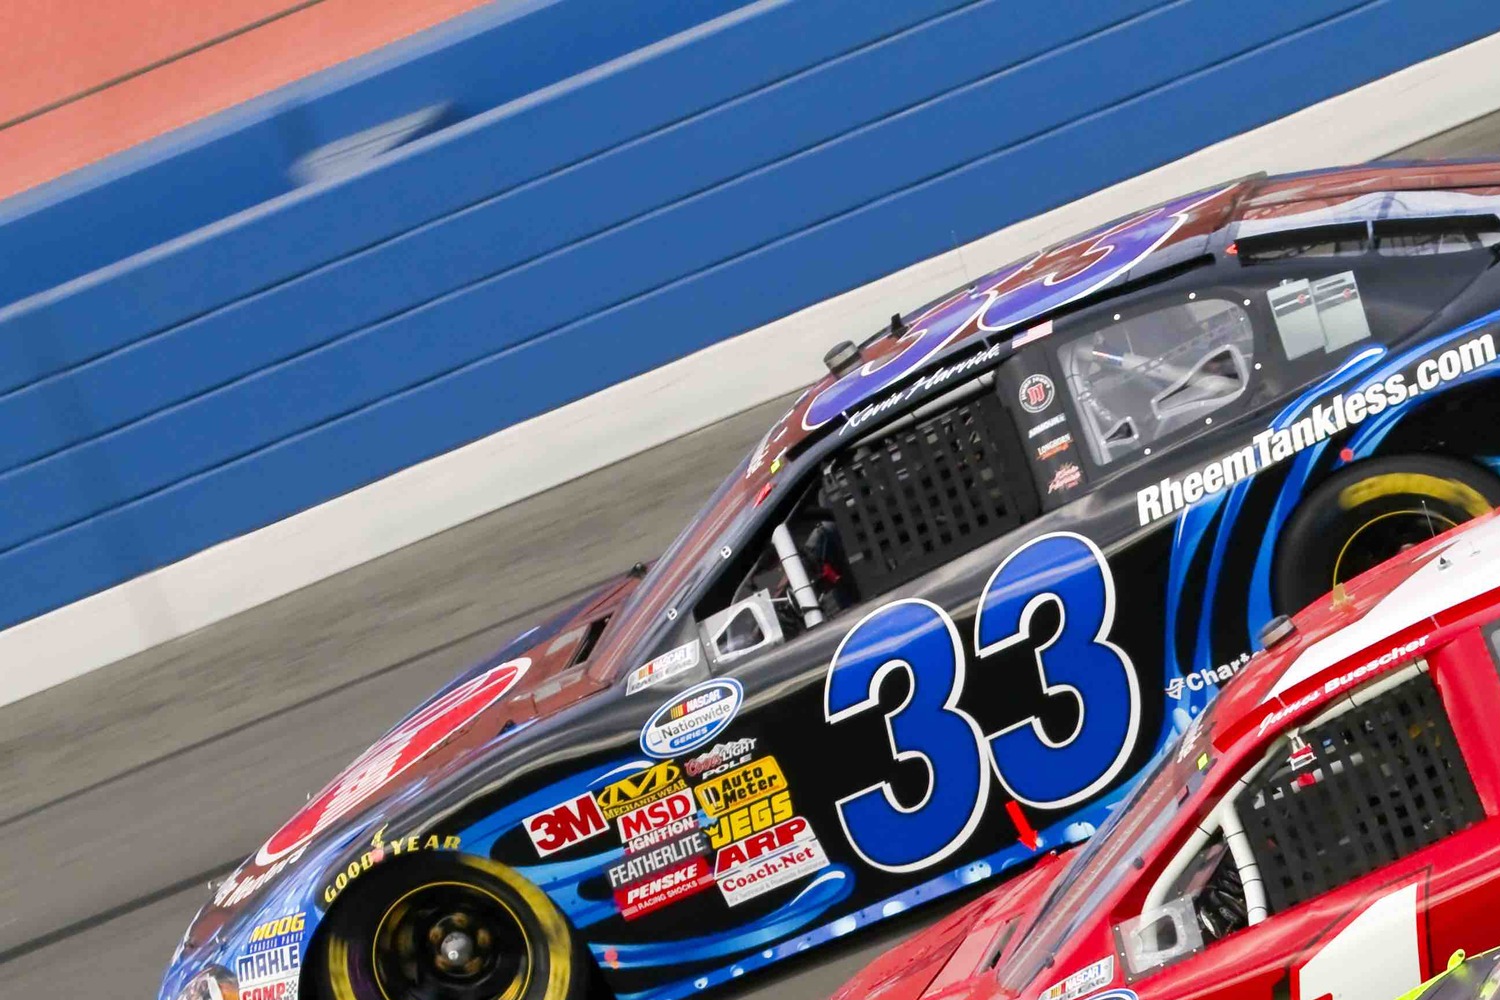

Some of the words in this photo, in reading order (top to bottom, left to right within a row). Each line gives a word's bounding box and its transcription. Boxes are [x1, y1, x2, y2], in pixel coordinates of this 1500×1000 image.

[839, 388, 902, 436] Kevin
[904, 342, 1001, 402] Harvick
[1137, 333, 1498, 527] RheemTankless.com
[1186, 649, 1265, 692] Chart
[1257, 690, 1321, 738] James
[1324, 633, 1430, 694] Buescher
[661, 702, 731, 738] Nationwide
[686, 689, 721, 713] NASCAR
[824, 531, 1141, 873] 33
[673, 726, 709, 747] SERIES
[721, 737, 758, 758] LIGHT
[702, 754, 752, 780] POLE
[721, 767, 762, 791] Auto
[604, 795, 658, 820] MECHANIX
[655, 779, 687, 802] WEAR
[724, 775, 777, 807] Meter
[530, 796, 604, 850] 3M
[624, 793, 692, 840] MSD
[628, 816, 695, 853] IGNITION
[711, 791, 793, 849] JEGS
[608, 834, 703, 887] FEATHERLITE
[716, 817, 807, 874] ARP
[628, 864, 698, 904] PENSKE
[722, 846, 815, 892] Coach-Net
[638, 892, 666, 911] RACING
[667, 881, 698, 900] SHOCKS
[250, 912, 306, 943] MOOG
[238, 945, 300, 982] MAHLE
[1064, 965, 1101, 992] NASCAR
